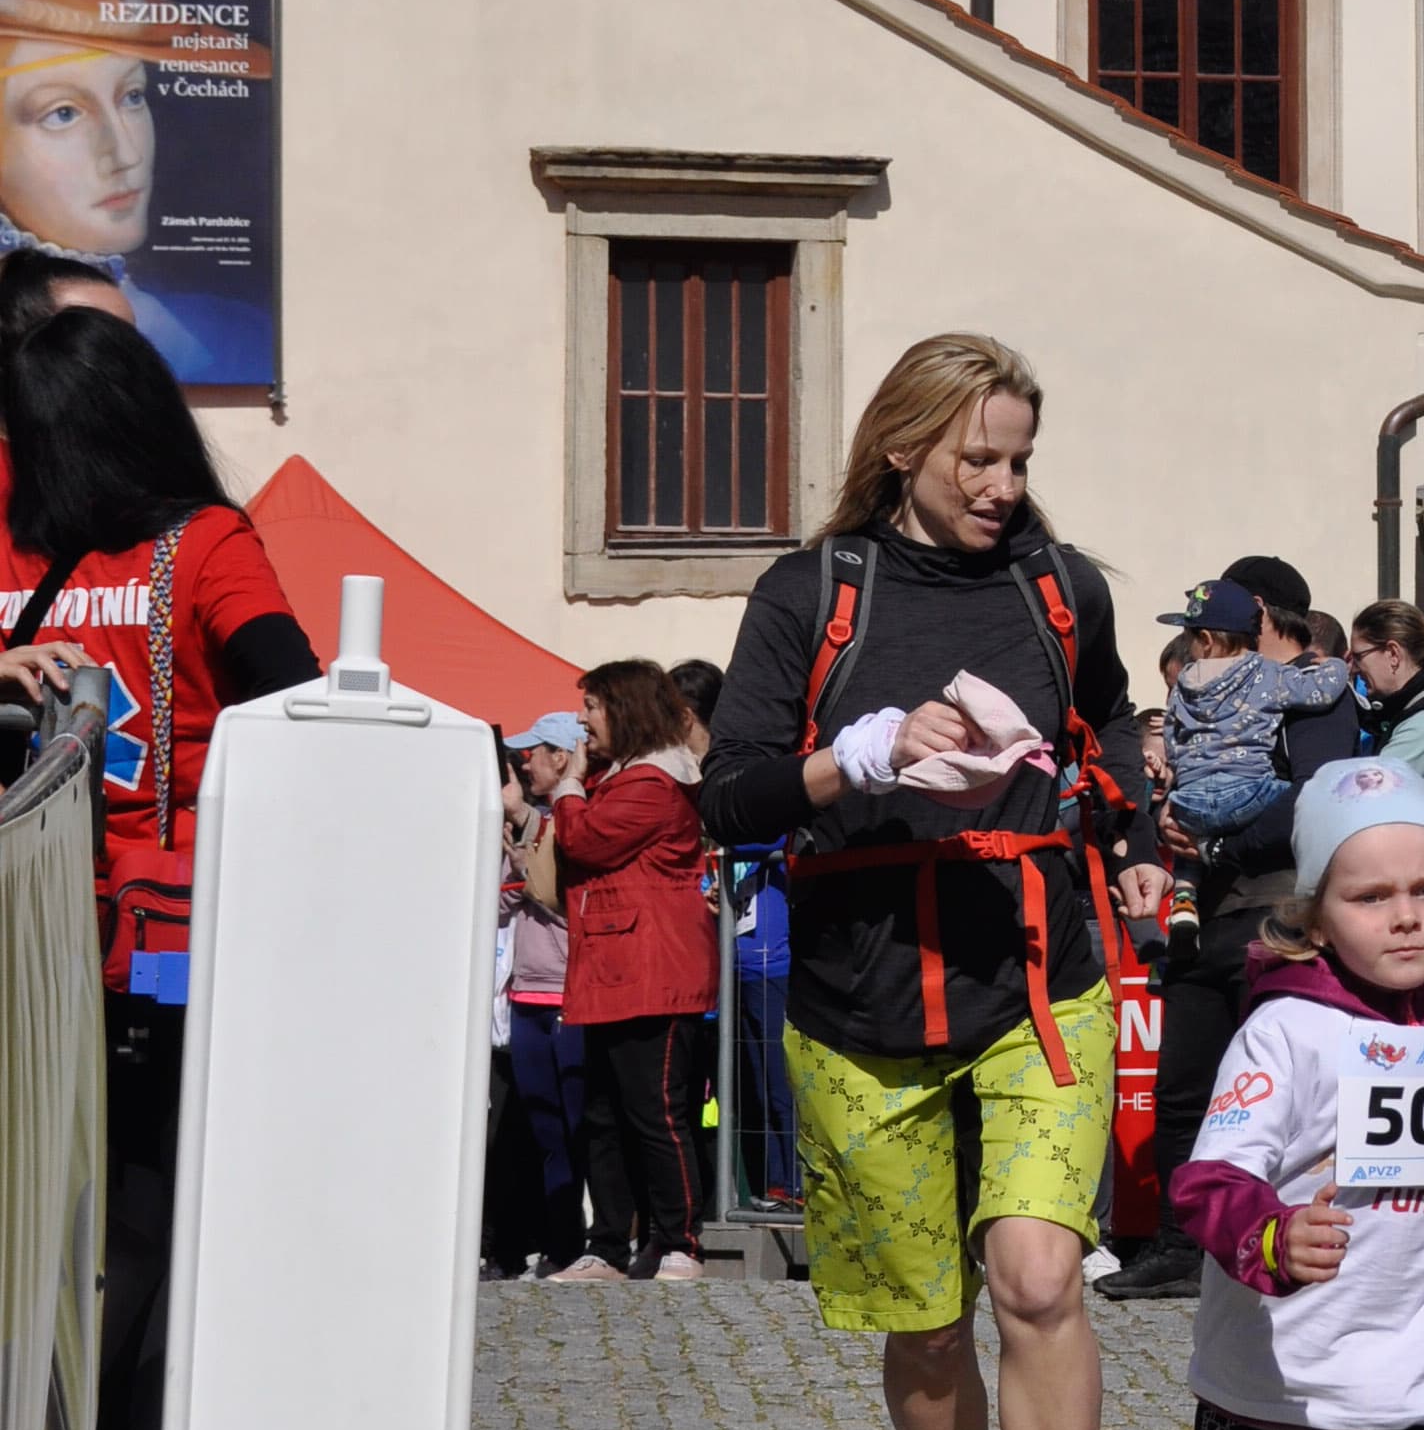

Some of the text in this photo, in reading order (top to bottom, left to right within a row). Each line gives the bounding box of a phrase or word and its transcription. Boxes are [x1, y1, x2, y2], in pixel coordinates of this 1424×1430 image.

[99, 2, 249, 26] REZIDENCE
[172, 32, 249, 52] nejstarší
[159, 59, 249, 73] renesance
[157, 77, 249, 97] v Čechách
[1208, 1110, 1251, 1128] PVZP
[1368, 1165, 1402, 1177] PVZP
